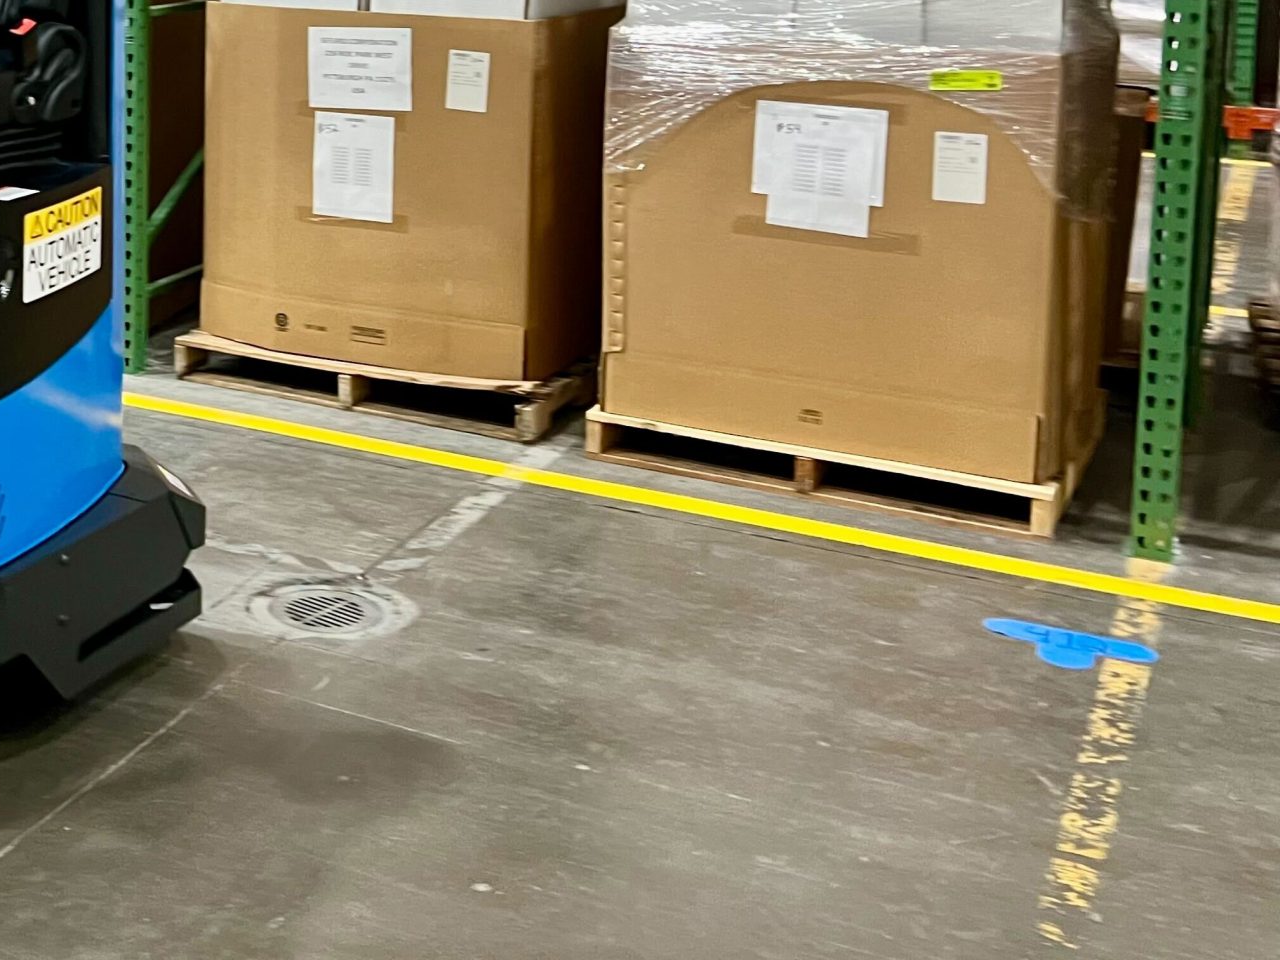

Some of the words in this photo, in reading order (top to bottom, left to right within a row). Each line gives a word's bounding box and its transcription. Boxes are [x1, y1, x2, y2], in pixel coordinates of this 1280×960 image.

[46, 191, 99, 233] CAUTION
[27, 221, 99, 272] AUTOMATIC
[38, 249, 91, 292] VEHICLE
